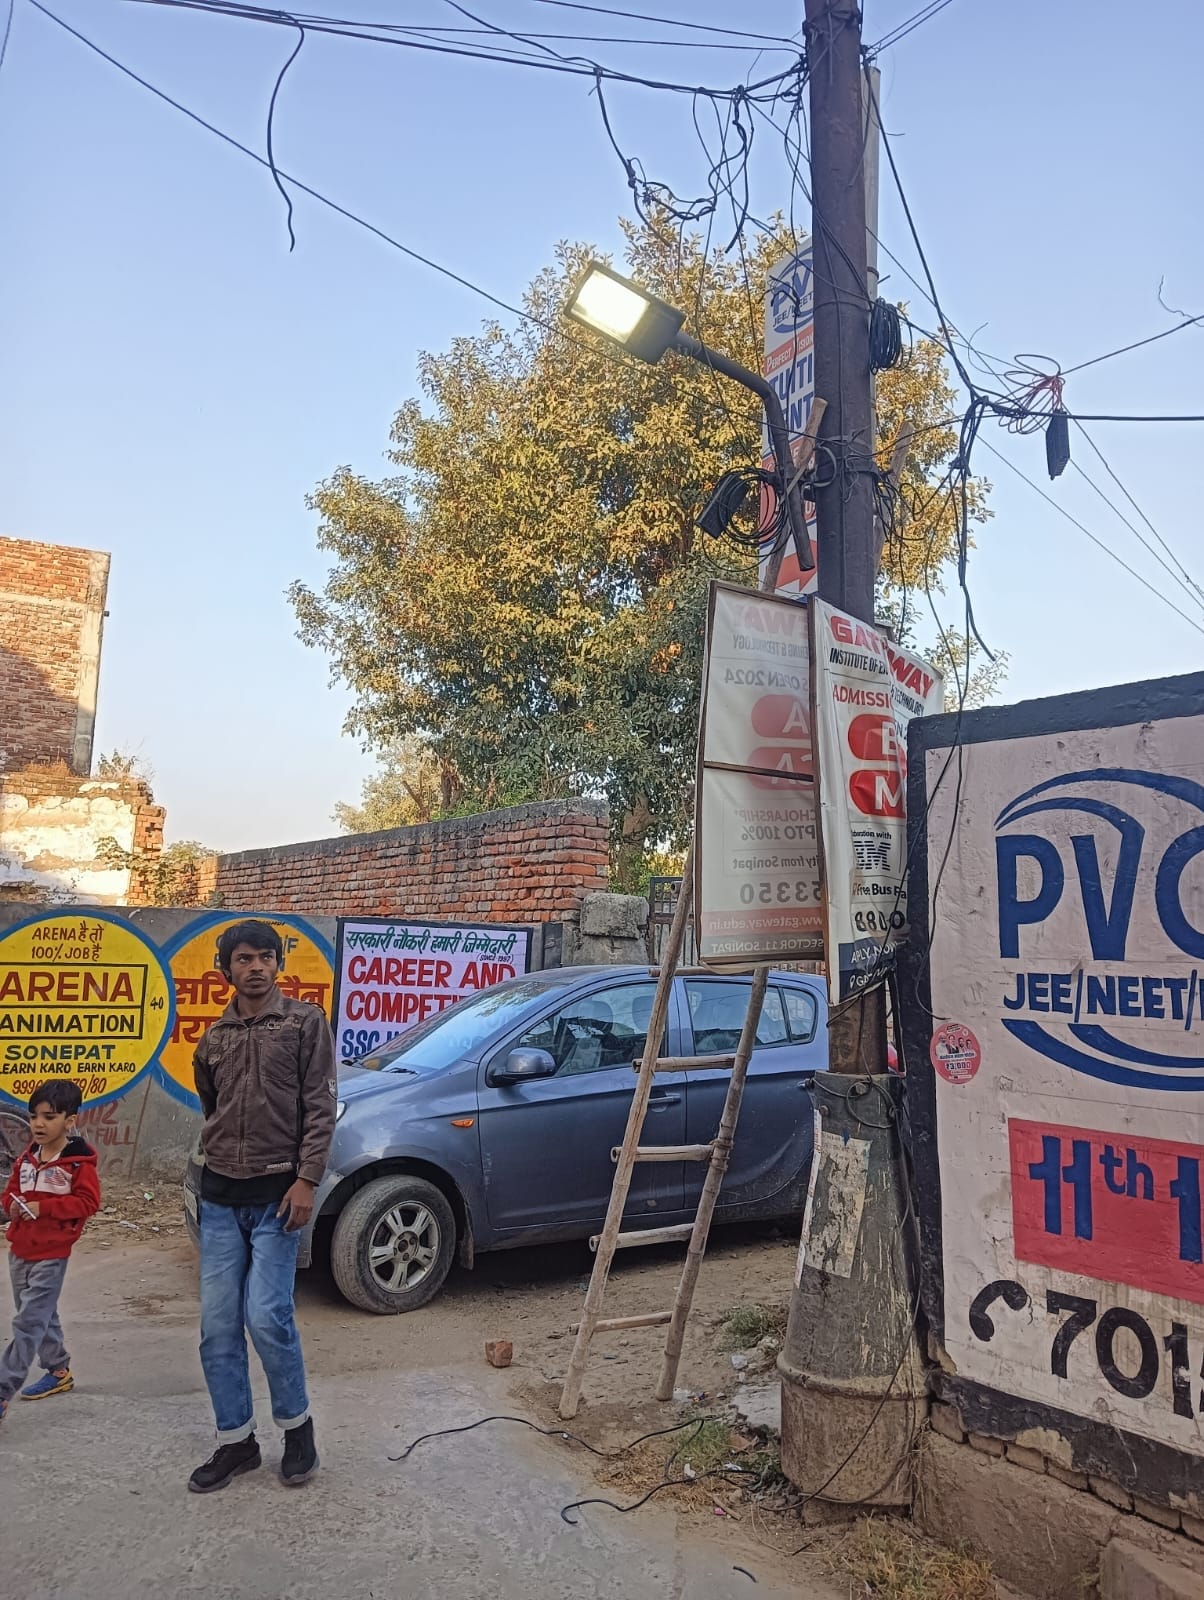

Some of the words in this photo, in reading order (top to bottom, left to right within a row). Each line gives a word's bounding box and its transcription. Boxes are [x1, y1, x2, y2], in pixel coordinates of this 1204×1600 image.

[767, 347, 791, 373] PERFECT
[830, 647, 868, 671] INSTITUTE
[876, 831, 892, 840] with
[872, 883, 892, 896] Bus
[32, 927, 76, 941] ARENA
[346, 926, 395, 952] सरकारी
[393, 927, 430, 954] नौकरी
[430, 930, 461, 954] हमारी
[31, 944, 63, 962] 100%
[65, 946, 90, 959] JOB
[347, 955, 452, 988] CAREER
[459, 961, 516, 989] AND
[0, 971, 134, 1002] ARENA
[346, 990, 468, 1023] COMPET
[1003, 968, 1204, 1031] JEE/NEET/
[0, 1014, 135, 1033] ANIMATION
[4, 1044, 116, 1060] SONEPAT
[40, 1062, 71, 1074] KARO
[77, 1062, 106, 1073] EARN
[109, 1062, 136, 1073] KARO
[1028, 1135, 1154, 1242] 11th
[1046, 1289, 1204, 1420] 701
